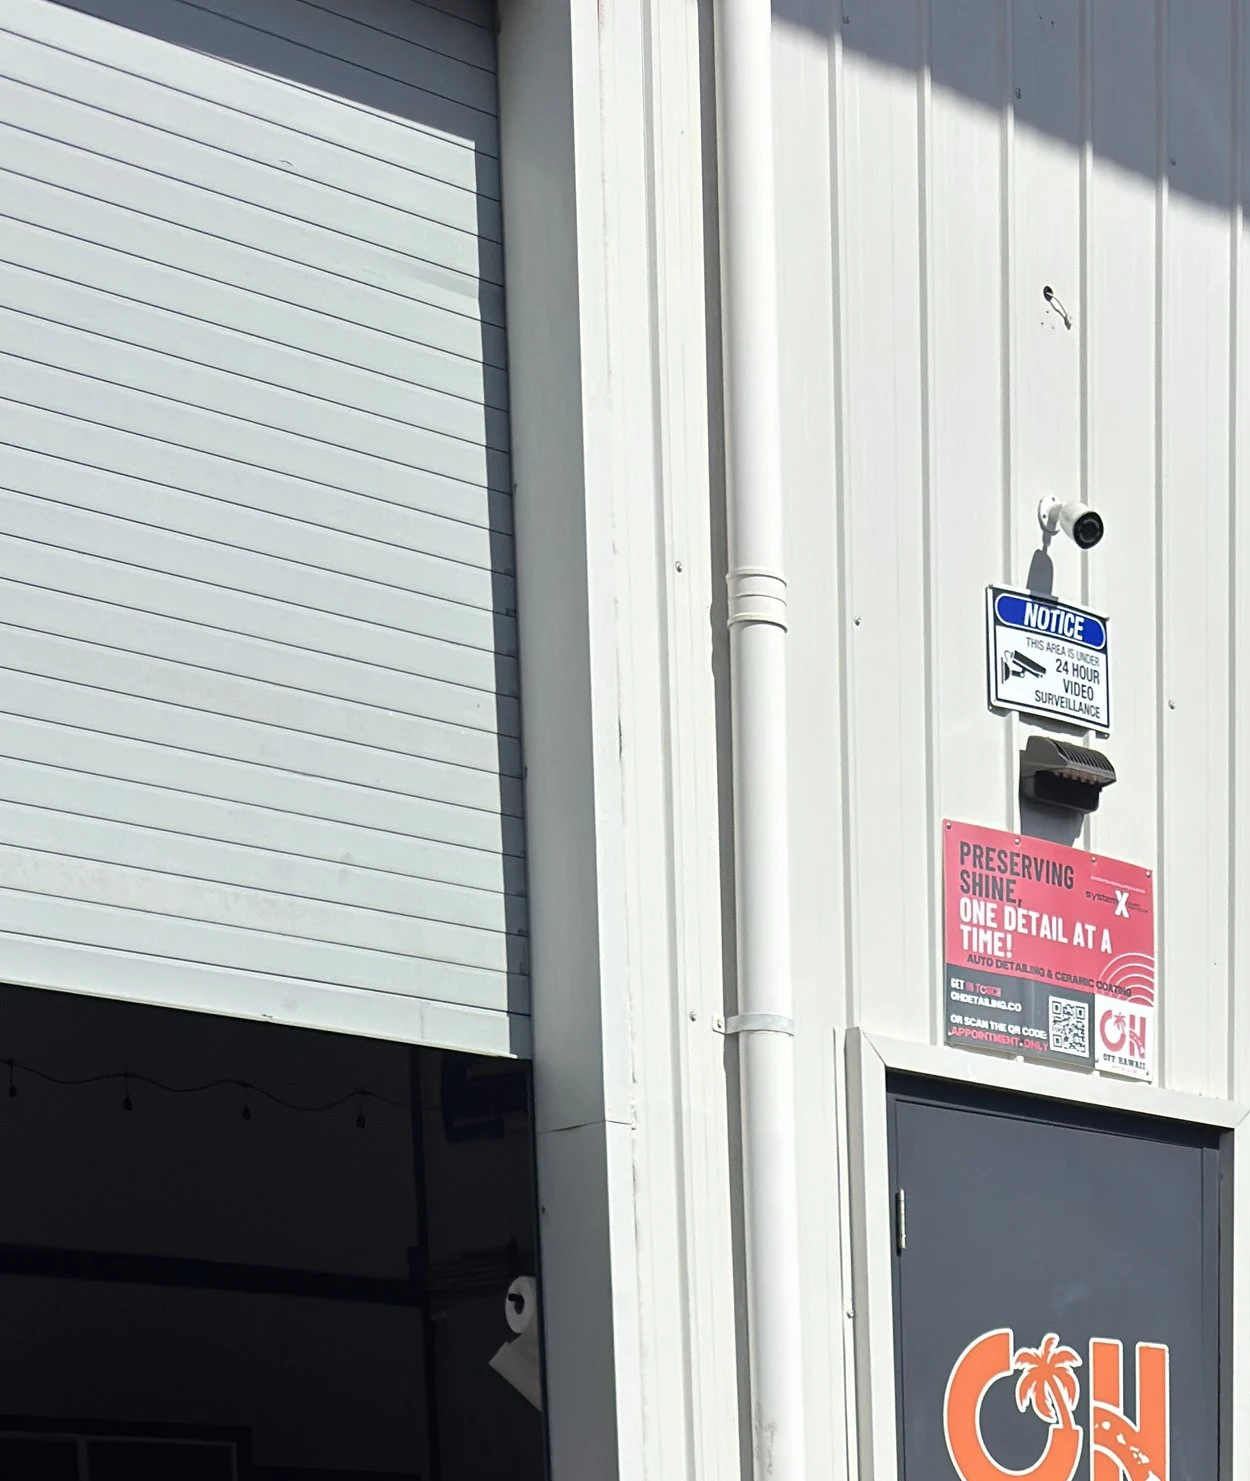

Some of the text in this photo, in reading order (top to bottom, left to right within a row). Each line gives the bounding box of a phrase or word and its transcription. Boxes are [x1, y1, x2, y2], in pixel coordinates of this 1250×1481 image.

[1024, 602, 1084, 640] NOTICE
[1026, 637, 1100, 666] THIS AREA IS UNDER
[1056, 659, 1100, 684] 24 HOUR
[1035, 690, 1100, 718] SURVEILLANCE
[1063, 679, 1094, 701] VIDEO
[960, 841, 1074, 889] PRESERVING
[960, 870, 1022, 907] SHINE,
[960, 897, 1112, 954] ONE DETAIL AT A
[960, 925, 1012, 958] TIME!
[950, 978, 964, 990] GET
[967, 954, 1132, 997] AUTO DETAILING & CERAMIC COATING
[950, 1014, 963, 1025] OR
[965, 1016, 988, 1029] SCAN
[990, 1020, 1007, 1033] THE
[1008, 1024, 1021, 1034] QR
[950, 1026, 1048, 1053] APPOINTMENT ONLY
[1118, 1057, 1146, 1069] HAWAII
